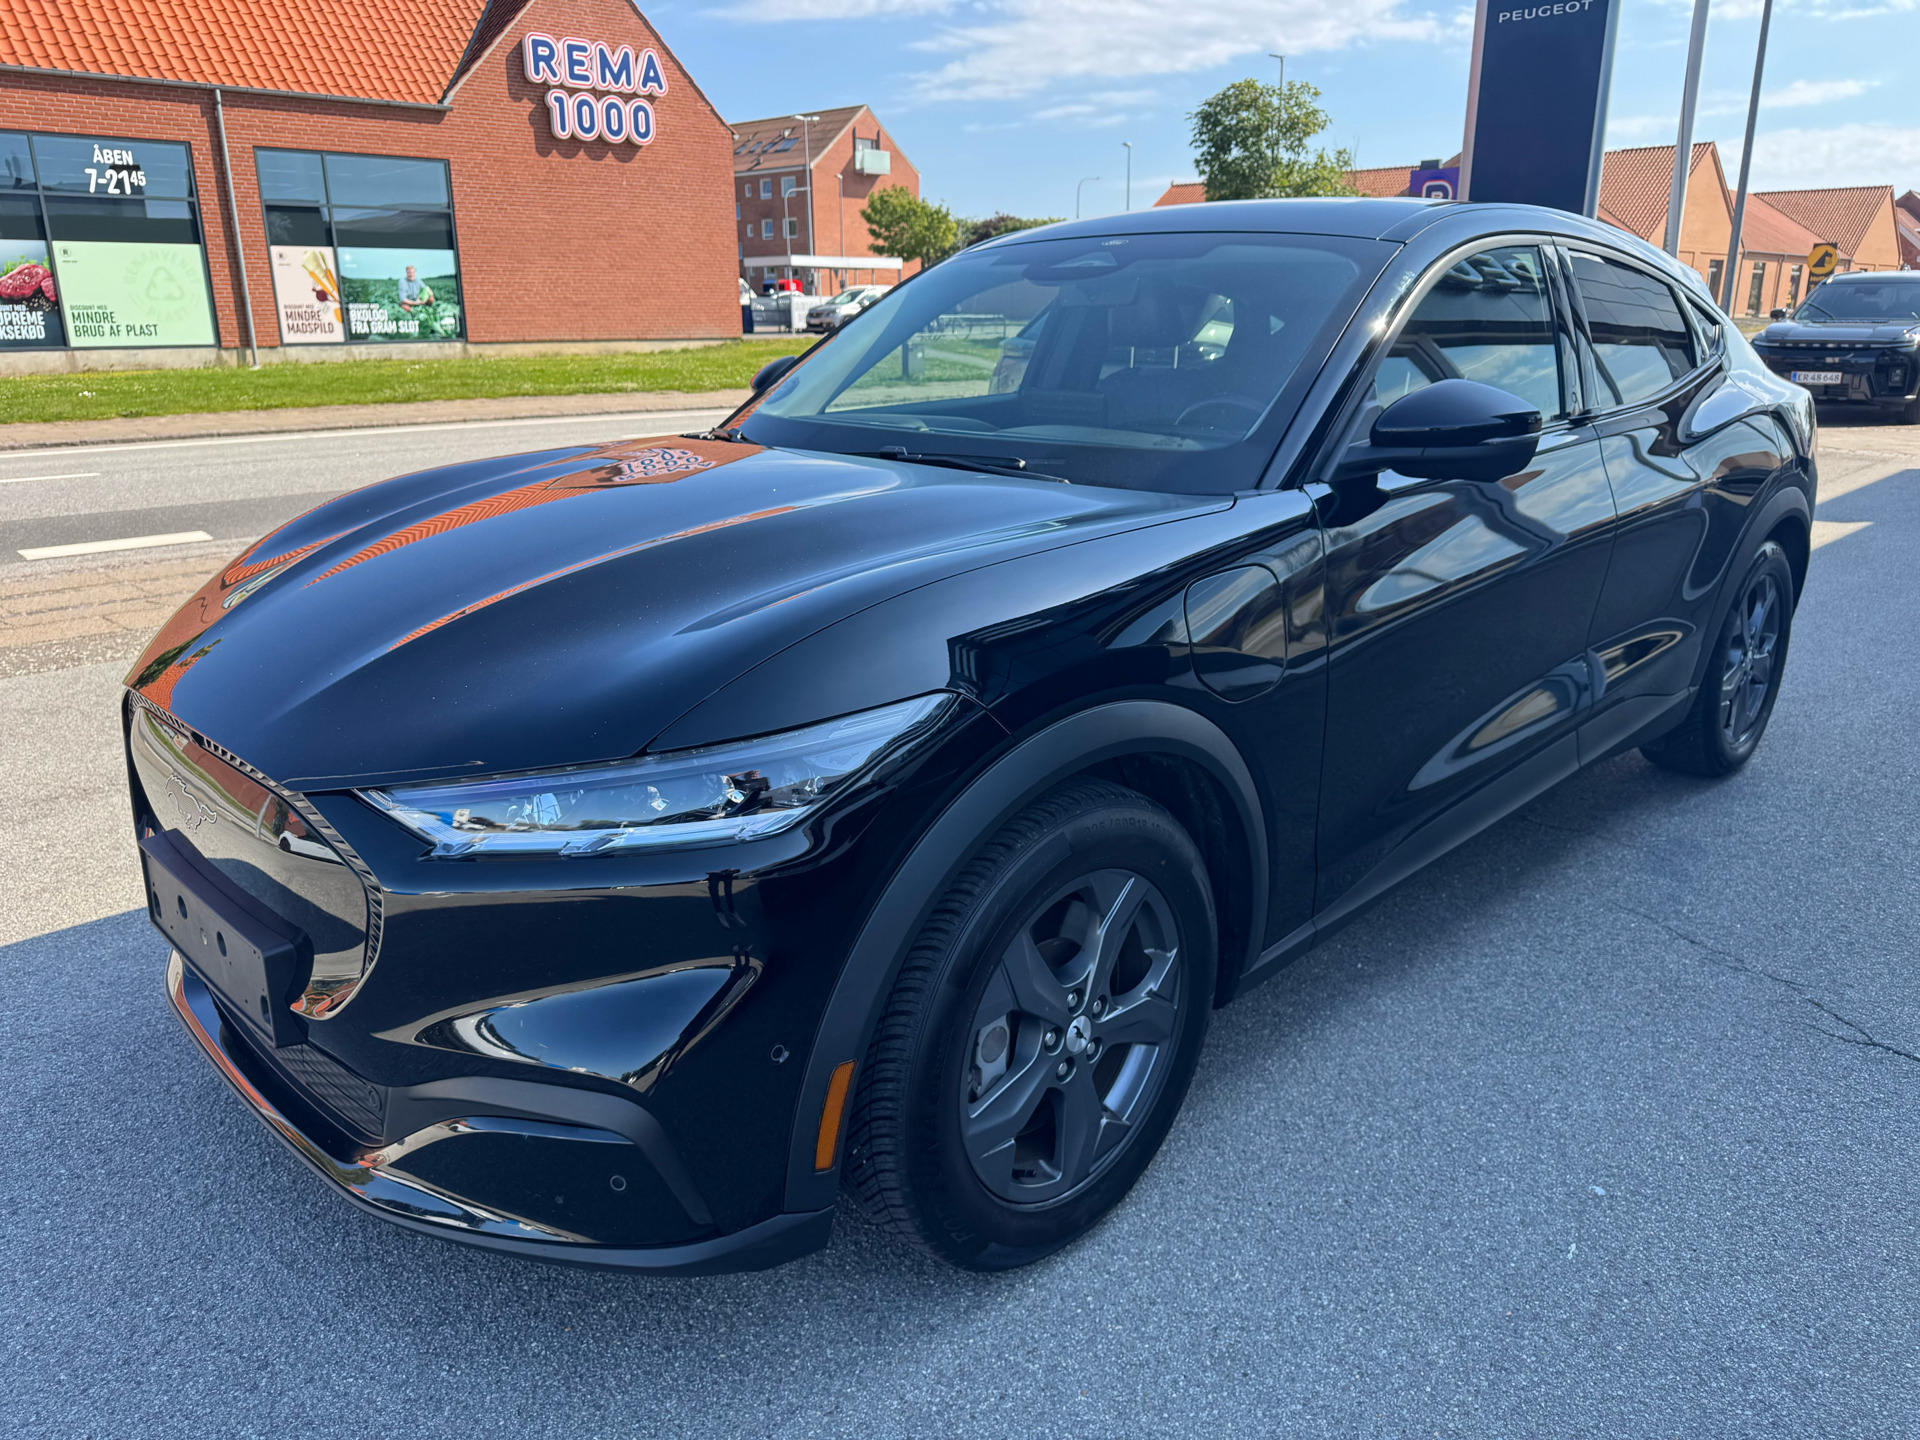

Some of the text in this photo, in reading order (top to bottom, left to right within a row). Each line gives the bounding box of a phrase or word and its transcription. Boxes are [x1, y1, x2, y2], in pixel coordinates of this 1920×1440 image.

[1498, 0, 1594, 24] PEUGEOT
[528, 35, 666, 93] REMA
[550, 92, 654, 142] 1000
[92, 144, 134, 166] ÅBEN
[71, 311, 117, 324] MINDRE
[285, 310, 322, 321] MINDRE
[349, 309, 389, 321] ØKOLOGI
[74, 323, 158, 338] BRUG AF PLAST
[287, 322, 335, 335] MADSPILD
[351, 319, 420, 334] FRA GRAM SLOT
